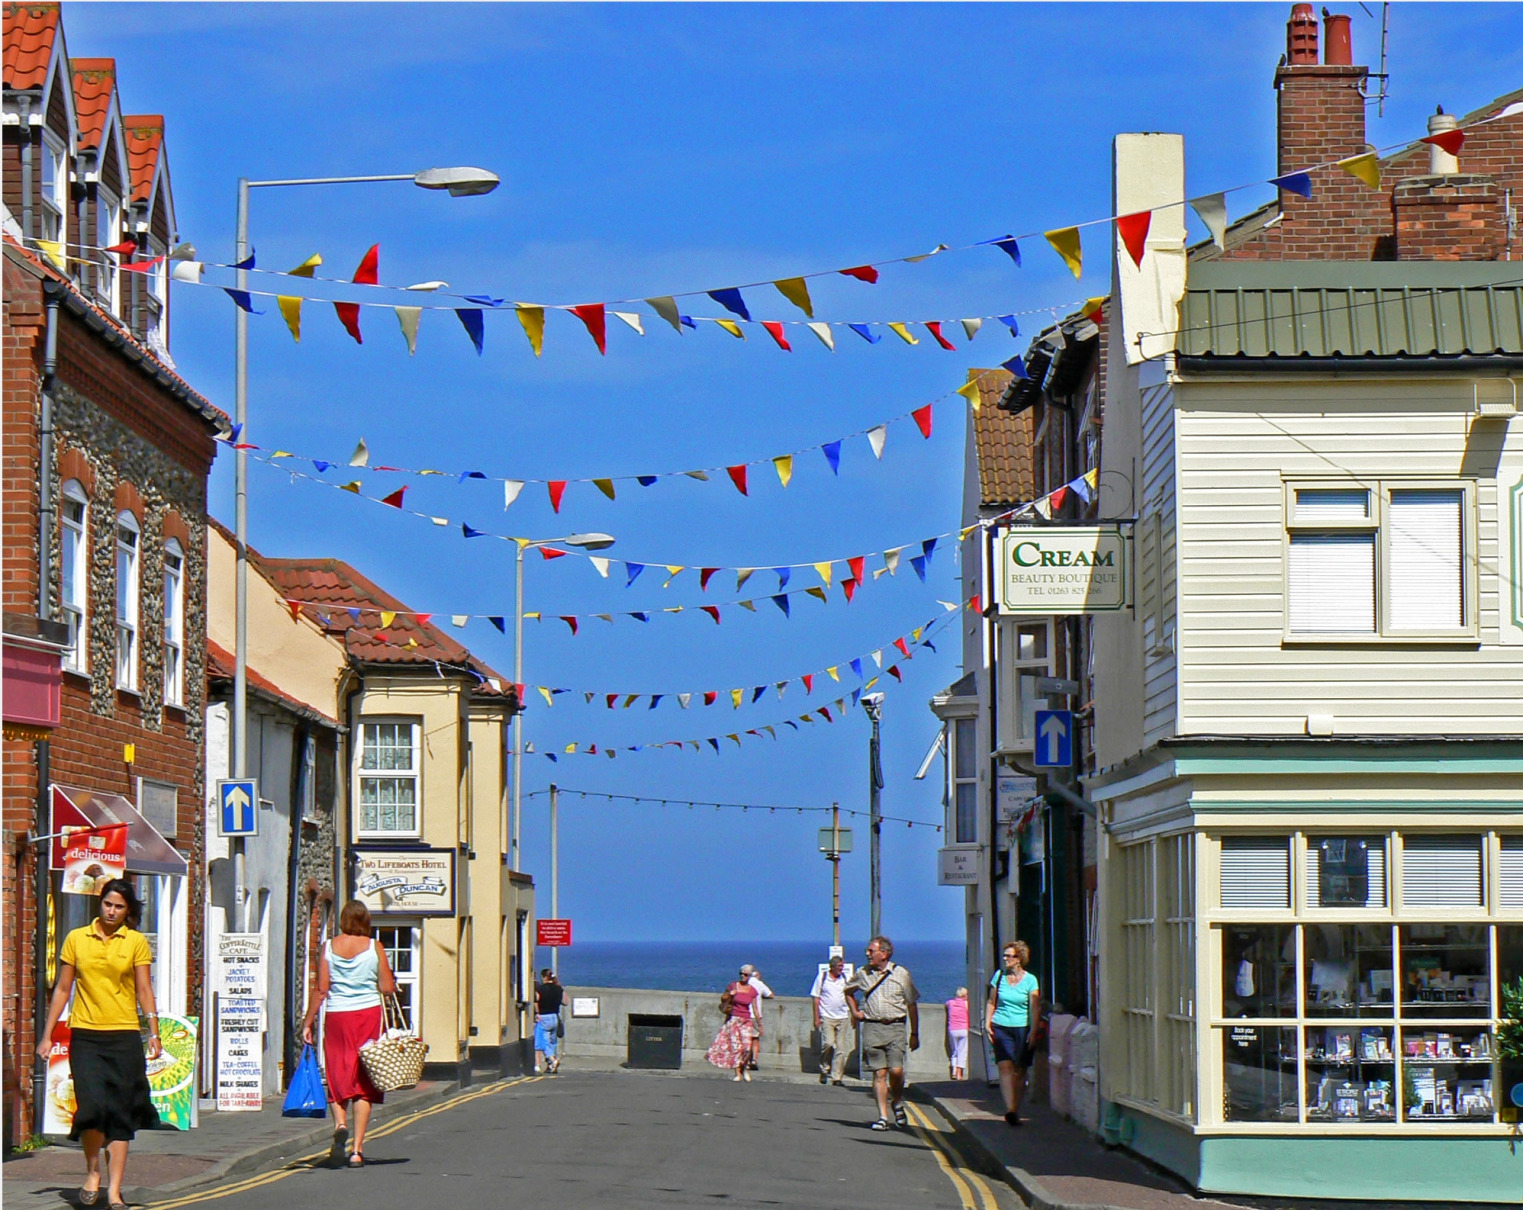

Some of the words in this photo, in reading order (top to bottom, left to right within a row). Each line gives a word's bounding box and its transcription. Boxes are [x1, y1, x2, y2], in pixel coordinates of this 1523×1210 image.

[1012, 541, 1114, 567] CREAM
[1011, 574, 1055, 583] BEAUTY
[1058, 573, 1117, 584] BOUTIQUE
[1027, 587, 1045, 595] TEL
[1047, 587, 1069, 595] 01263
[71, 847, 120, 862] delicious
[361, 860, 376, 869] TWO
[378, 860, 420, 869] LIFEBOATS
[422, 860, 447, 869] HOTEL
[944, 872, 976, 880] RESTAURANT
[368, 878, 403, 892] AUGUSTA
[400, 885, 438, 894] DUNCAN
